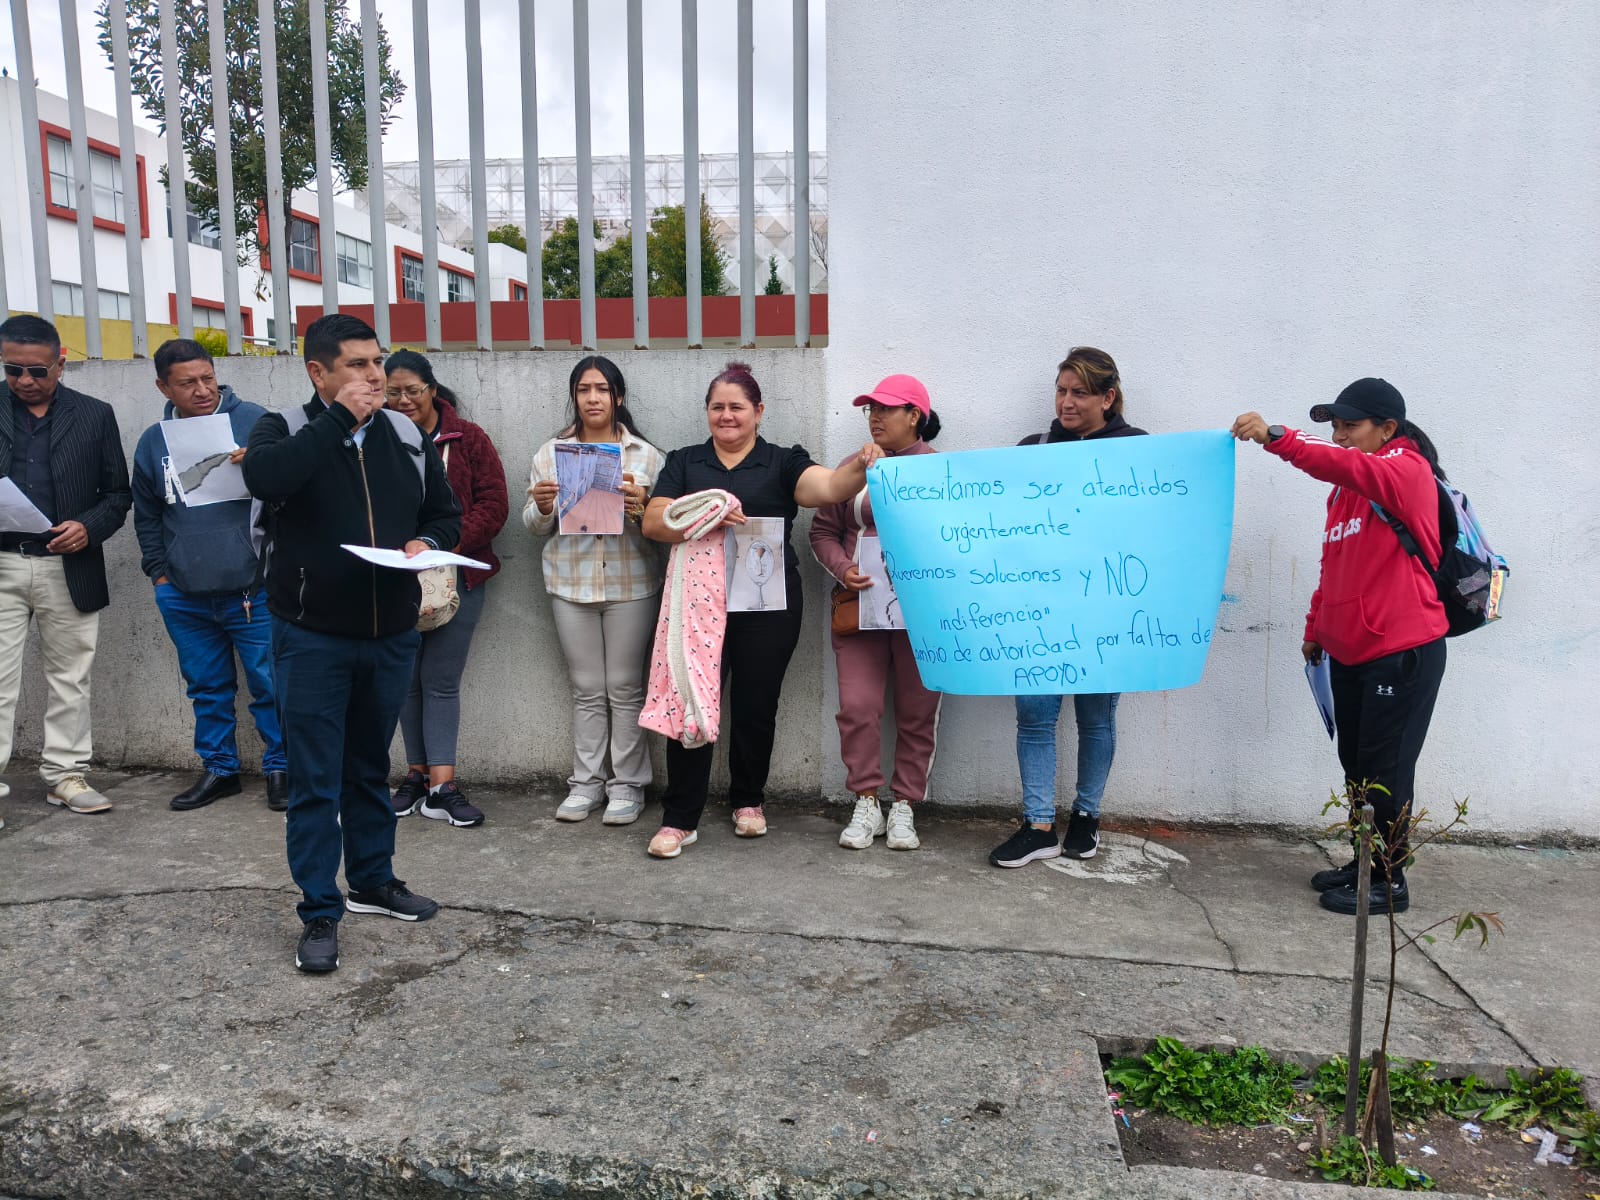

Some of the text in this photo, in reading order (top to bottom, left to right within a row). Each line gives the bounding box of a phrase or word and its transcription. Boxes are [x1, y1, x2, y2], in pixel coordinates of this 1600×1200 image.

[1023, 481, 1063, 500] ser
[1083, 459, 1188, 497] atendidos
[970, 558, 1061, 585] soluciones
[1104, 552, 1148, 597] NO
[954, 634, 972, 662] de
[979, 624, 1080, 662] autoridad
[1096, 633, 1118, 664] por
[1128, 610, 1182, 648] falta
[1191, 618, 1211, 645] de
